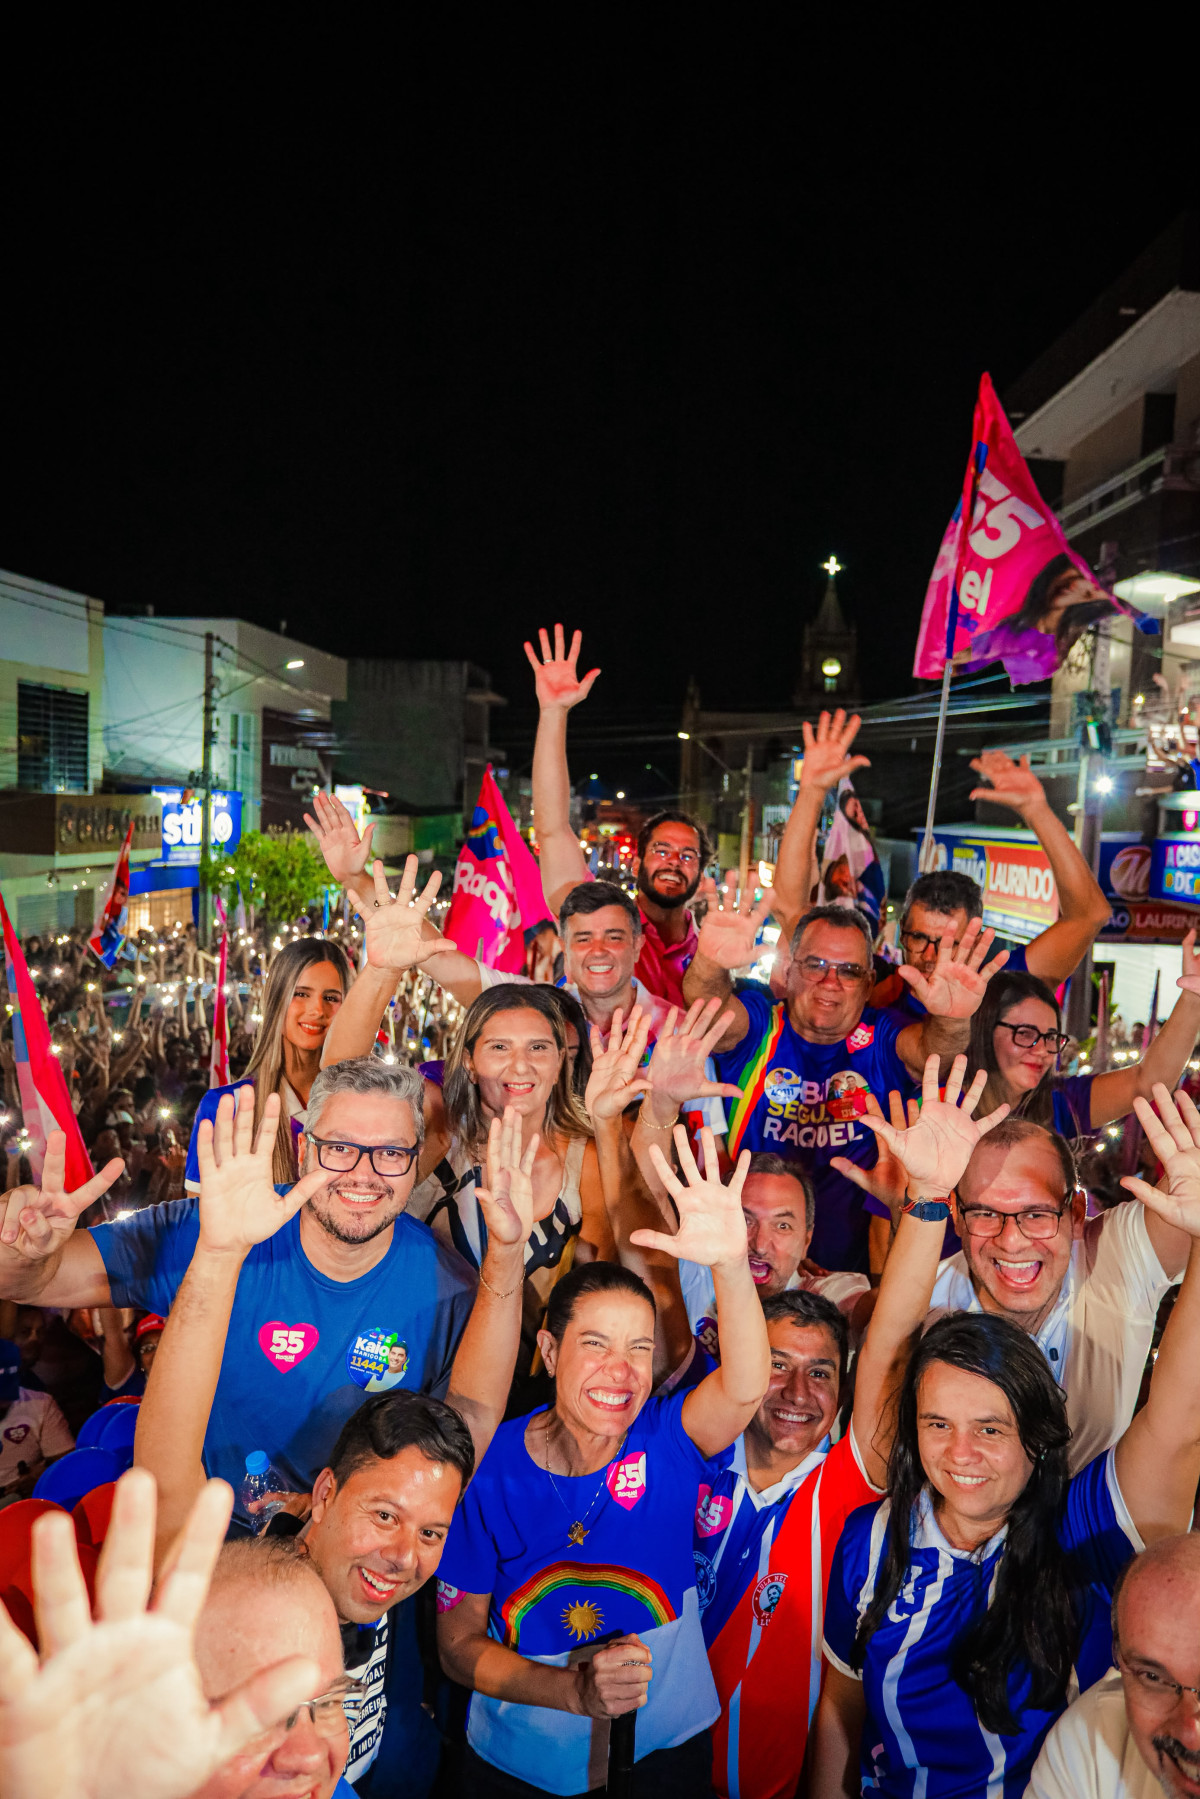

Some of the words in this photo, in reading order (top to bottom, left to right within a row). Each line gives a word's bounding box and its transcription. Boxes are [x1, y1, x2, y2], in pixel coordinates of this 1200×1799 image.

[989, 861, 1054, 903] LAURINDO
[763, 1116, 864, 1148] RAQUEL
[269, 1329, 306, 1354] 55
[355, 1336, 390, 1357] Kaio
[350, 1355, 384, 1373] 11444
[615, 1462, 643, 1492] 55
